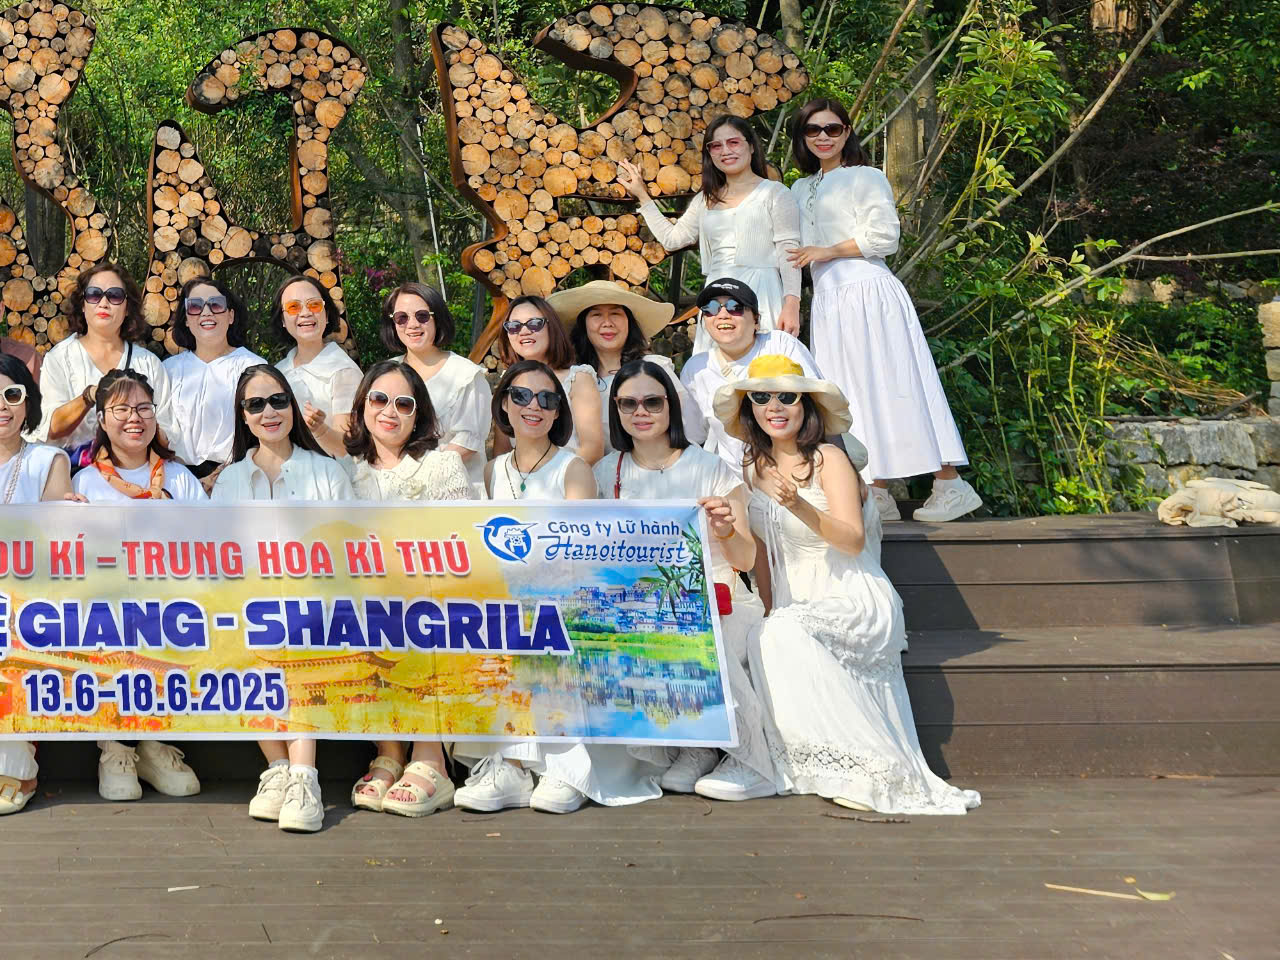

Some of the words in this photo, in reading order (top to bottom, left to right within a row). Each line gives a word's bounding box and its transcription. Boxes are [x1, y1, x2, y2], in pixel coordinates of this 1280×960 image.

[547, 520, 591, 537] Công
[595, 522, 611, 537] ty
[617, 519, 636, 535] Lữ
[640, 520, 680, 536] hành
[49, 532, 86, 576] KÍ
[122, 540, 245, 577] TRUNG
[257, 540, 334, 576] HOA
[346, 532, 386, 574] KÌ
[396, 534, 471, 575] THÚ
[538, 535, 691, 563] Hanoitourist
[18, 600, 207, 648] GIANG
[245, 599, 571, 652] SHANGRILA
